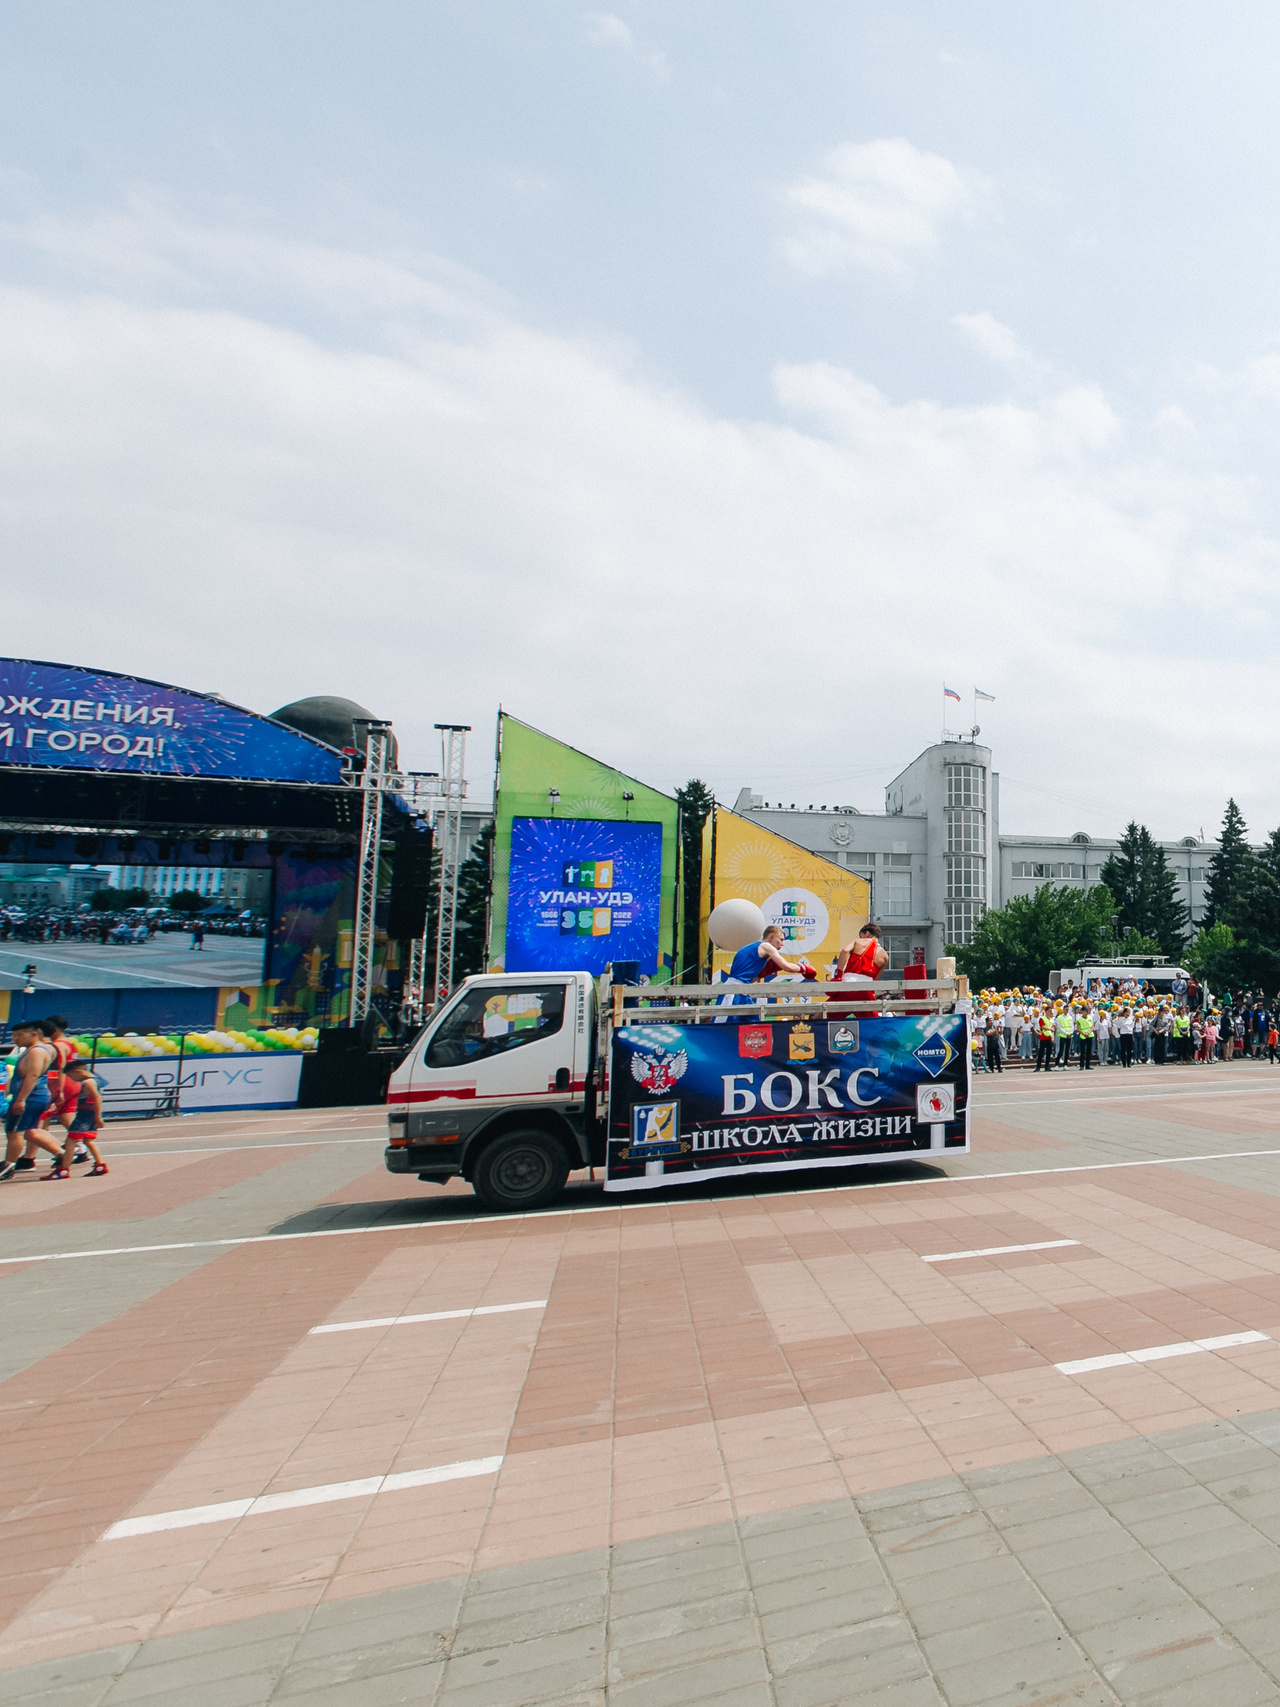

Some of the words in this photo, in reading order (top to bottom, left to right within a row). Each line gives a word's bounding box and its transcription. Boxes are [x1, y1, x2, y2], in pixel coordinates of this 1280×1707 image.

[0, 696, 182, 729] ЖДЕНИЯ,
[25, 728, 166, 759] ГОРОД!
[539, 891, 634, 907] УЛАН-УДЭ
[613, 911, 632, 919] 2022
[771, 917, 816, 925] УЛАН-УДЭ
[917, 1048, 946, 1056] НОМТО
[130, 1068, 263, 1087] АРИГУС
[721, 1067, 882, 1116] БОКС
[691, 1123, 803, 1152] ШКОЛА
[812, 1116, 912, 1142] ЖИЗНИ
